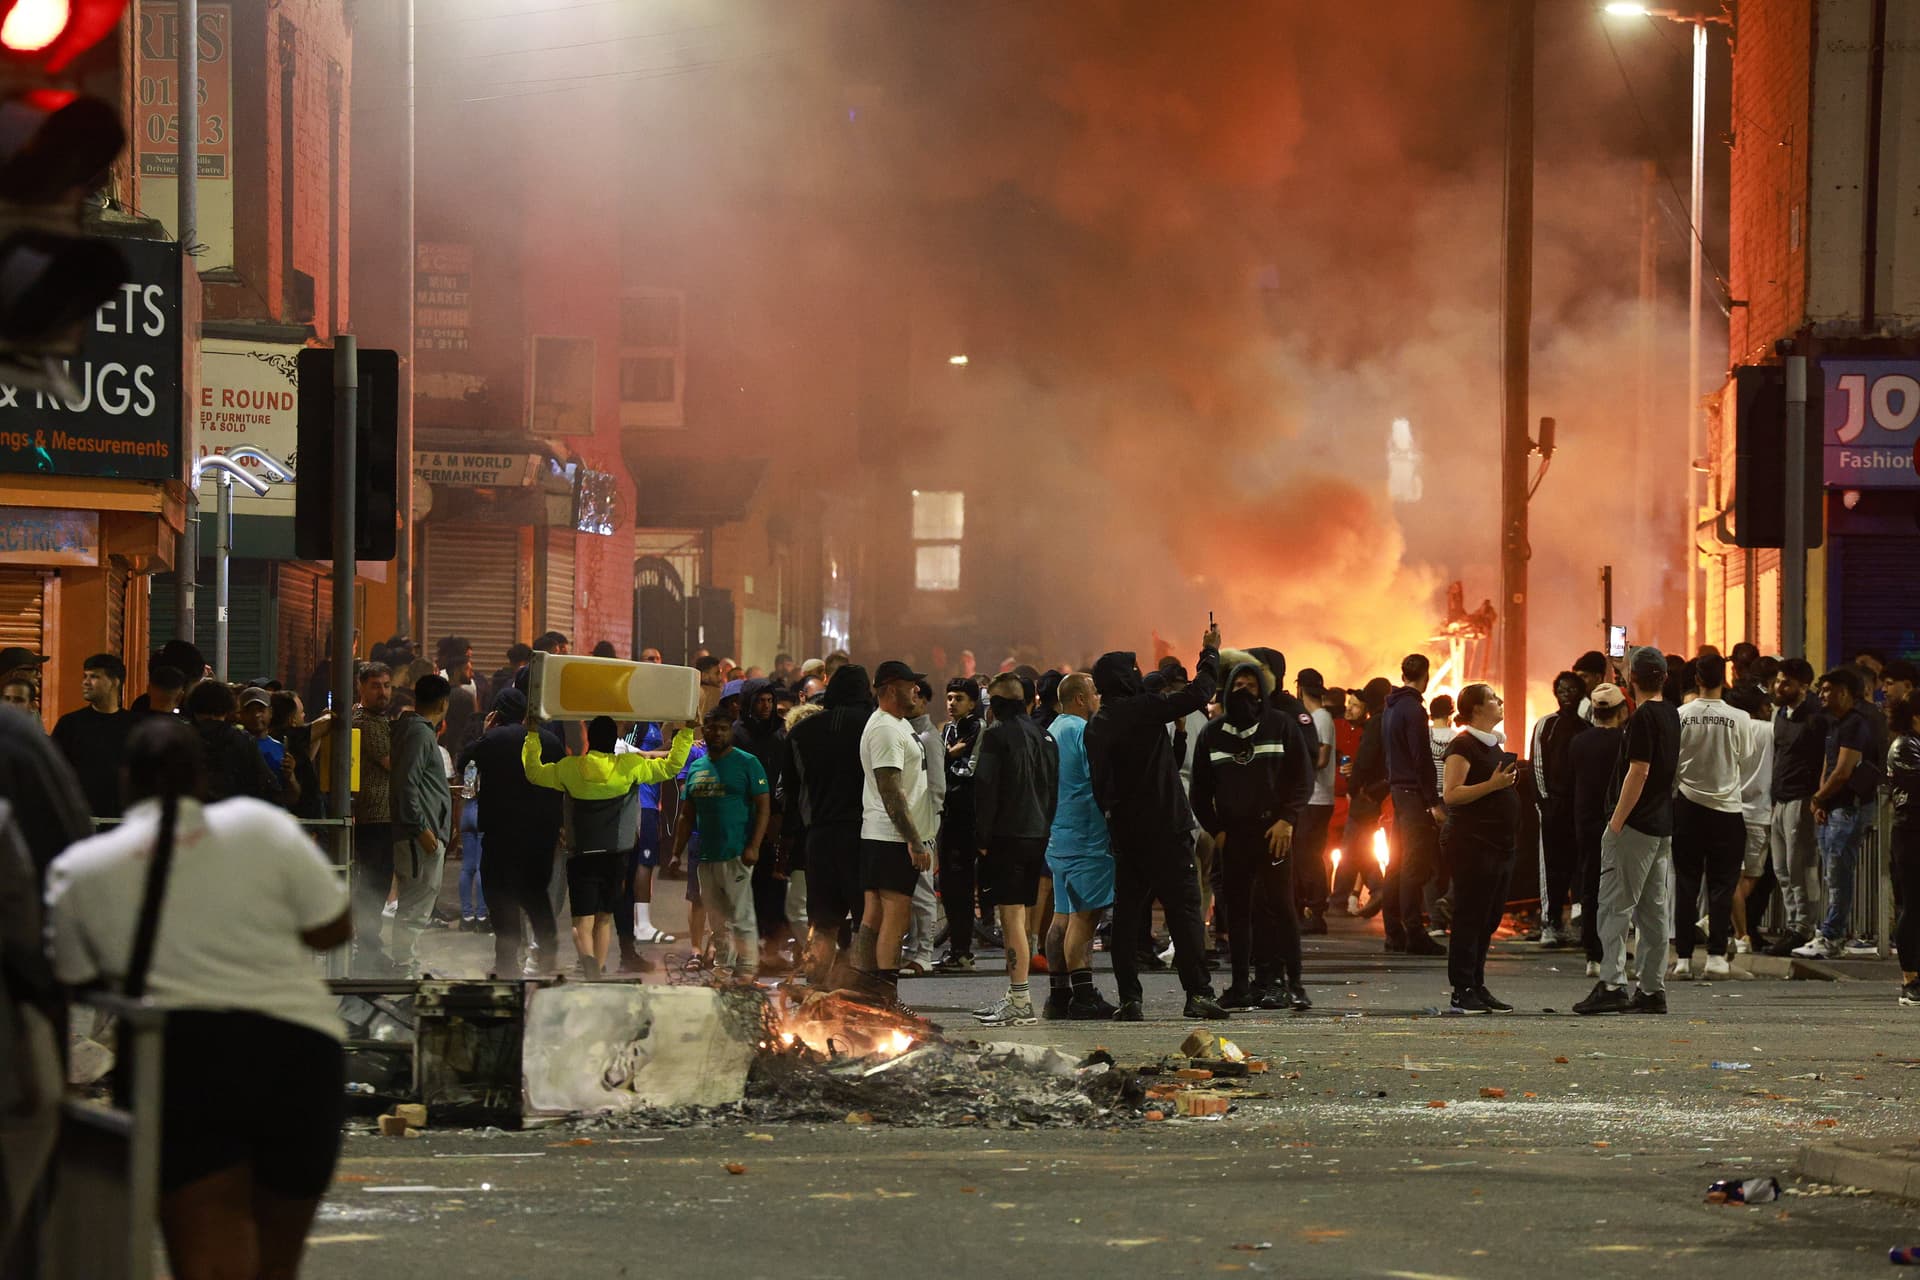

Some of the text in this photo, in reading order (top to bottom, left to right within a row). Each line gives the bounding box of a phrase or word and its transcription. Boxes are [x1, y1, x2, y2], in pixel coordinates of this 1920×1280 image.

[146, 113, 225, 145] 053
[146, 164, 176, 174] Driving
[416, 291, 470, 305] MARKET
[95, 283, 166, 337] ETS
[222, 388, 294, 411] ROUND
[216, 412, 271, 424] FURNITURE
[1835, 373, 1920, 445] JO
[209, 421, 217, 431] &
[219, 422, 246, 432] SOLD
[34, 429, 47, 447] &
[52, 430, 169, 458] Measurements
[432, 454, 442, 466] &
[447, 455, 458, 467] M
[463, 456, 512, 468] WORLD
